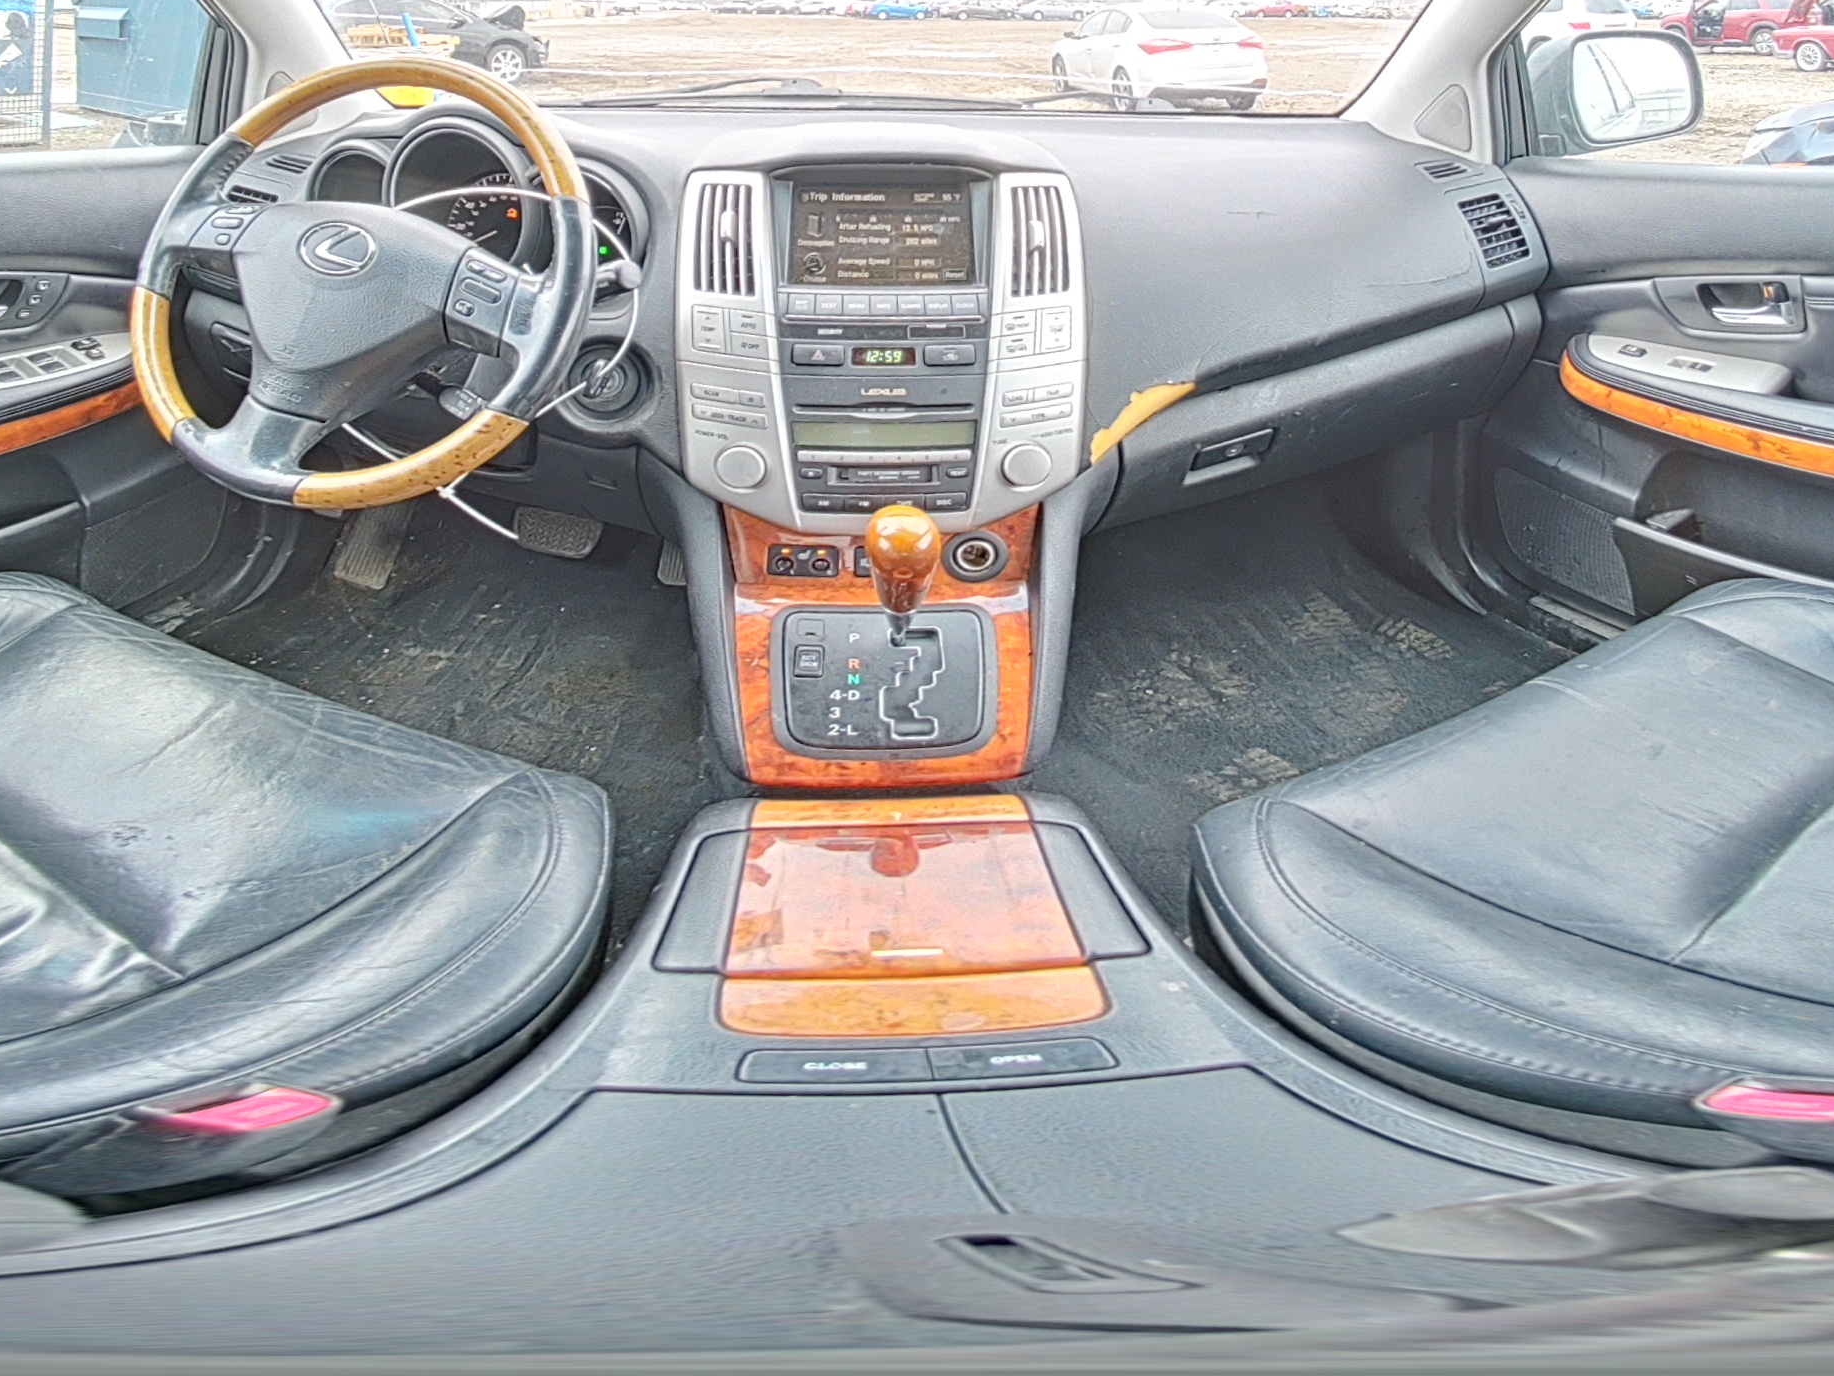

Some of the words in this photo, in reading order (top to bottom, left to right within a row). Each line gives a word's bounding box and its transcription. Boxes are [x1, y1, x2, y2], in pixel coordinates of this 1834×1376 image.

[809, 192, 827, 202] Trip
[832, 192, 885, 202] Information
[838, 222, 857, 232] After
[859, 223, 892, 232] Refueling
[838, 235, 867, 245] Cruising
[869, 236, 890, 245] Range
[838, 257, 867, 266] Average
[868, 257, 890, 266] Speed
[838, 270, 869, 279] Distance
[820, 301, 837, 310] DEST
[847, 302, 865, 310] MENU
[955, 301, 975, 310] CLOCK
[700, 325, 716, 333] TEMP
[740, 322, 757, 330] AUTO
[866, 350, 902, 363] 12:59
[860, 387, 907, 396] LEXUS
[1008, 394, 1024, 402] LOAD
[1030, 412, 1046, 420] TYPE
[849, 633, 860, 644] P
[848, 659, 860, 669] R
[848, 674, 860, 685] N
[829, 689, 860, 701] 4-D
[829, 707, 841, 718] 3
[827, 724, 858, 736] 2-L
[989, 1052, 1042, 1066] OPEN
[803, 1060, 868, 1071] CLOSE
